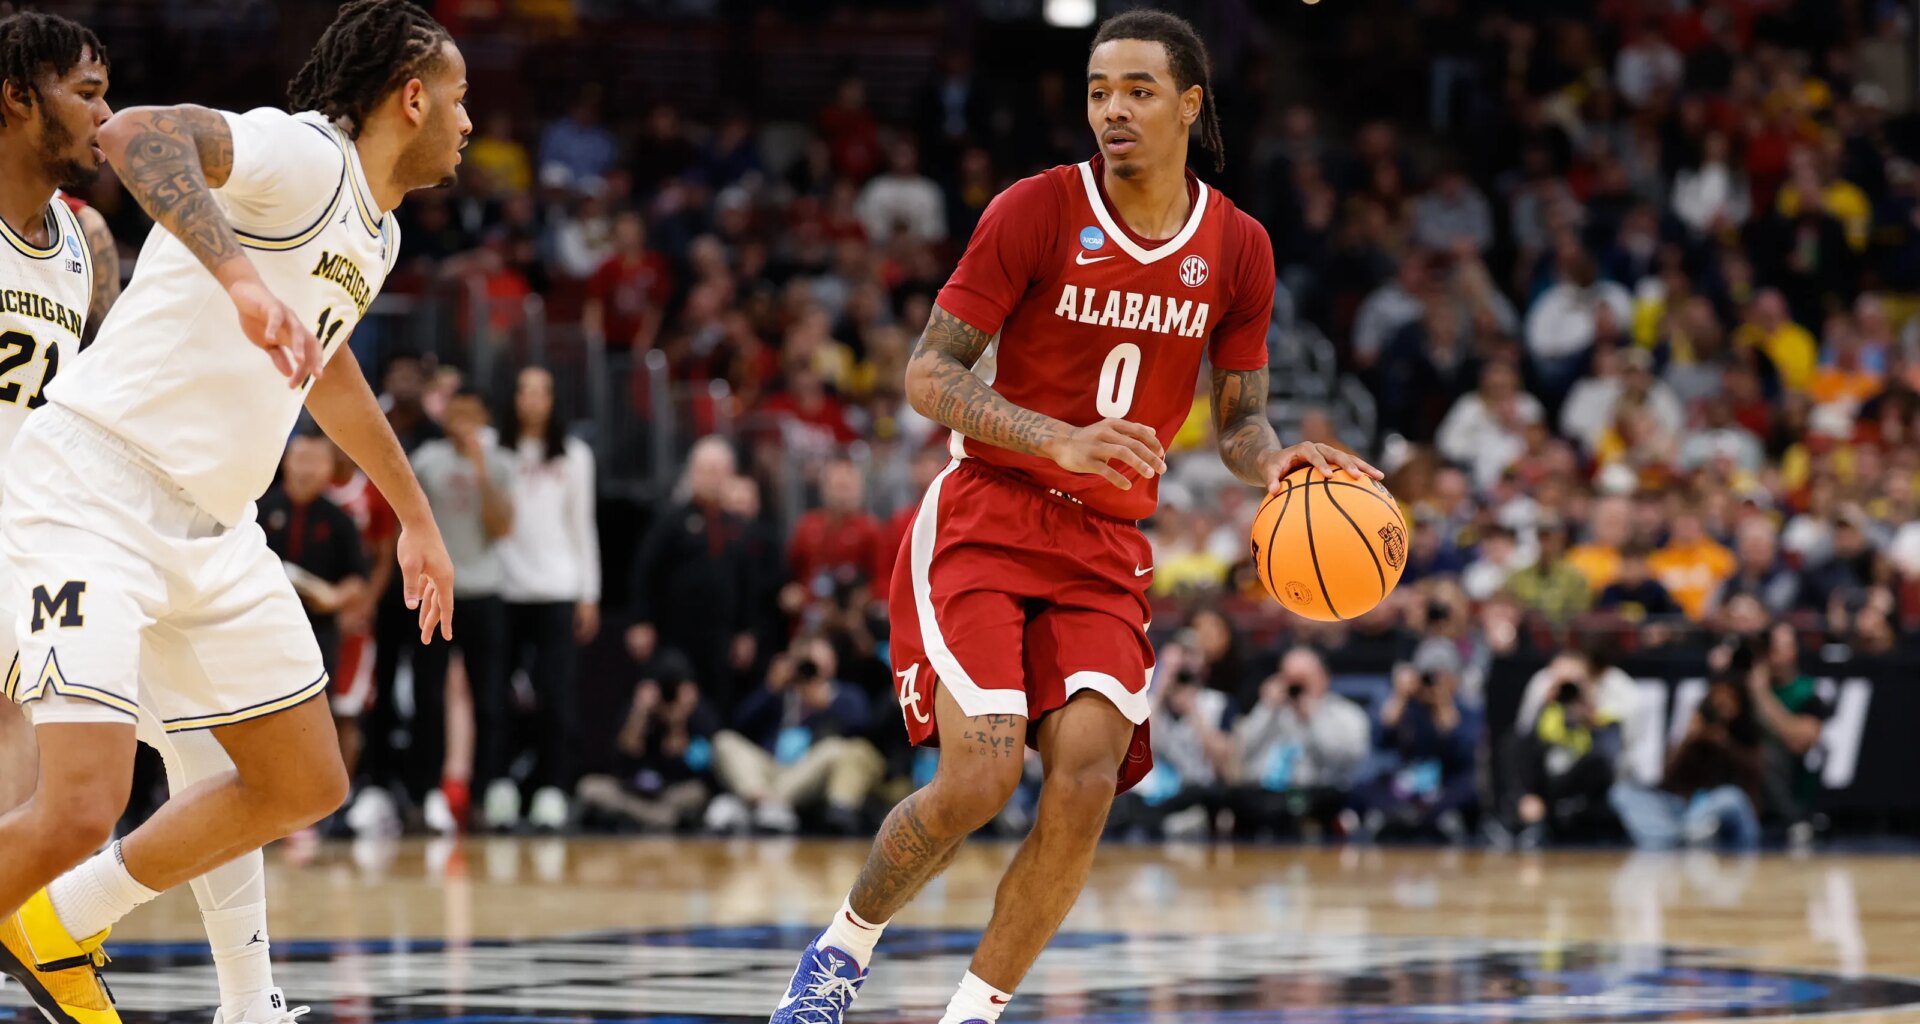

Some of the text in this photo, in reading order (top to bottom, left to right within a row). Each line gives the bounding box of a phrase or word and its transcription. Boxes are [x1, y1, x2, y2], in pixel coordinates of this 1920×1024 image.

[1082, 236, 1103, 245] NCAA
[1181, 256, 1207, 285] SEC
[1055, 284, 1210, 338] ALABAMA
[0, 329, 59, 410] 21
[1096, 342, 1141, 419] 0
[31, 580, 87, 634] M
[896, 662, 930, 730] A
[963, 730, 1016, 748] LIVE
